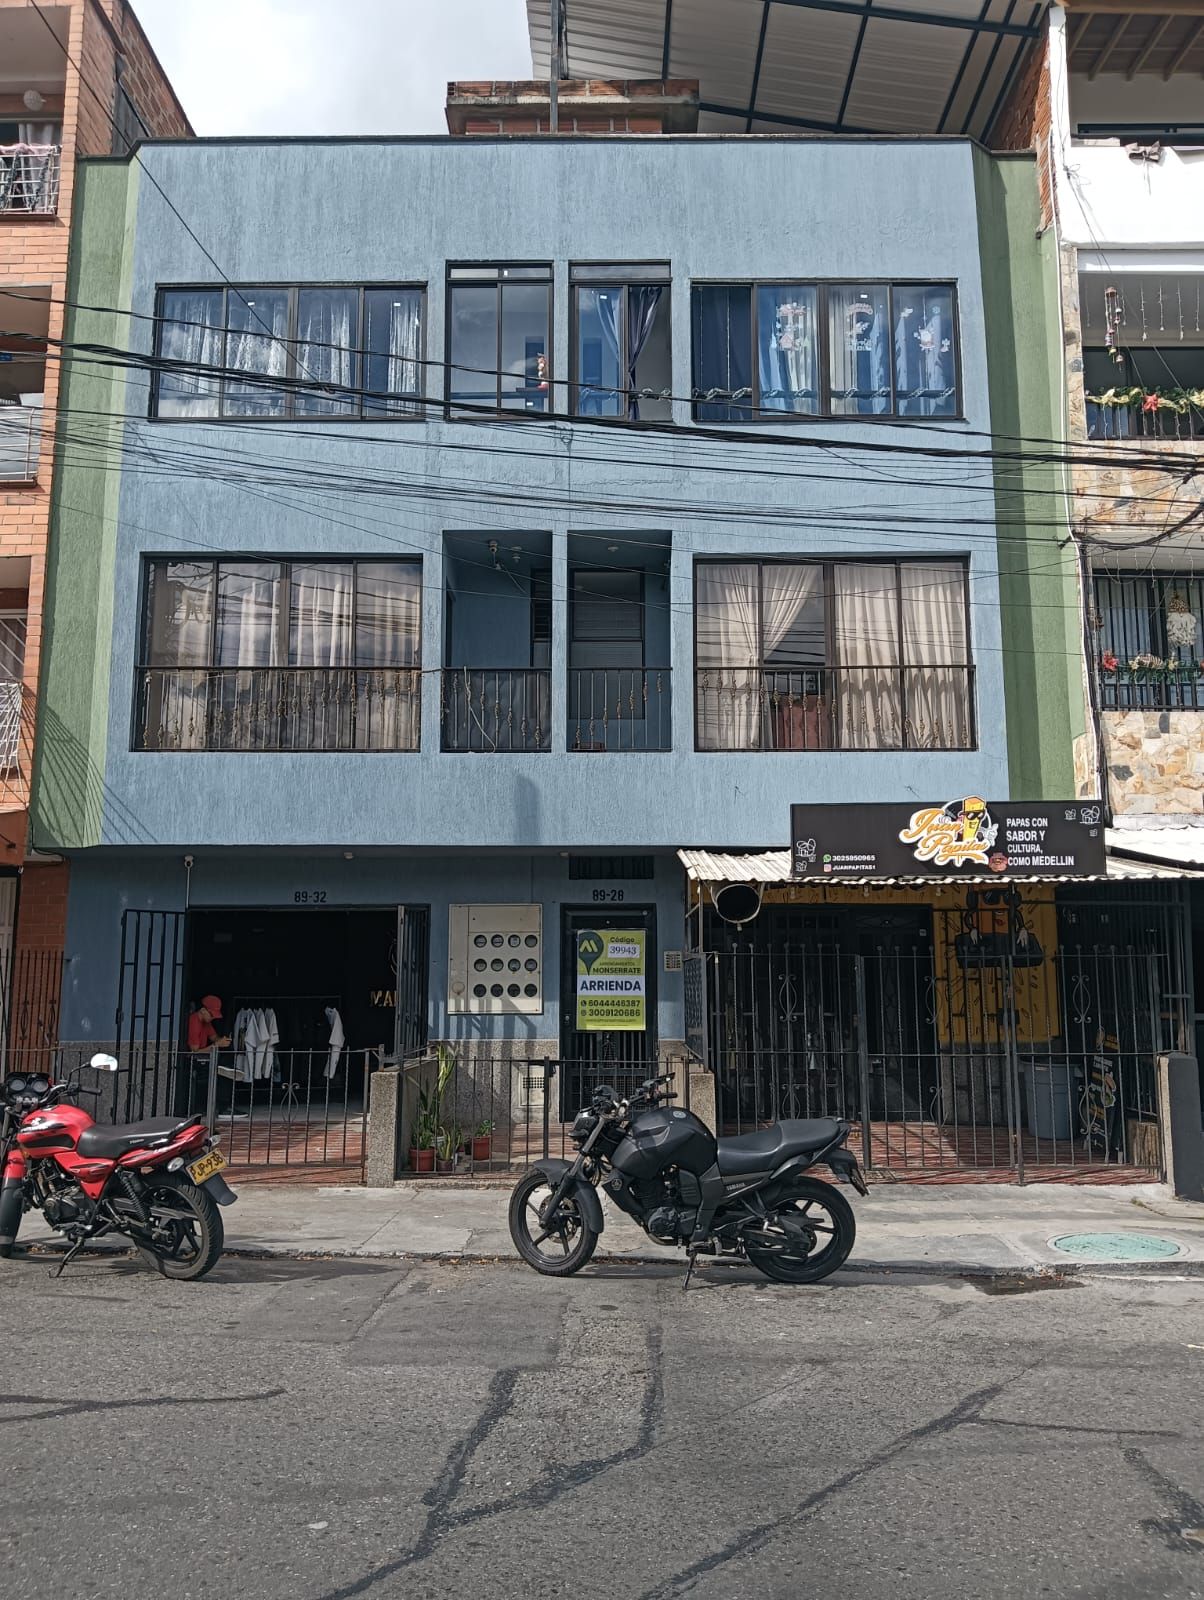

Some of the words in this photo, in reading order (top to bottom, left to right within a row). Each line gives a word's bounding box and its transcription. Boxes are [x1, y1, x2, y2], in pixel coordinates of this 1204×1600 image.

[902, 808, 964, 840] Juan
[1006, 818, 1030, 827] PAPAS
[1031, 818, 1048, 827] CON
[1006, 830, 1037, 841] SABOR
[1039, 830, 1046, 841] Y
[918, 832, 989, 866] Papitas
[1007, 844, 1043, 855] CULTURA,
[1007, 857, 1031, 866] COMO
[1031, 855, 1075, 866] MEDELLIN
[294, 891, 327, 903] 89-32
[592, 889, 625, 902] 89-28
[609, 936, 635, 945] Código
[609, 945, 637, 955] 39943
[580, 980, 642, 991] ARRIENDA
